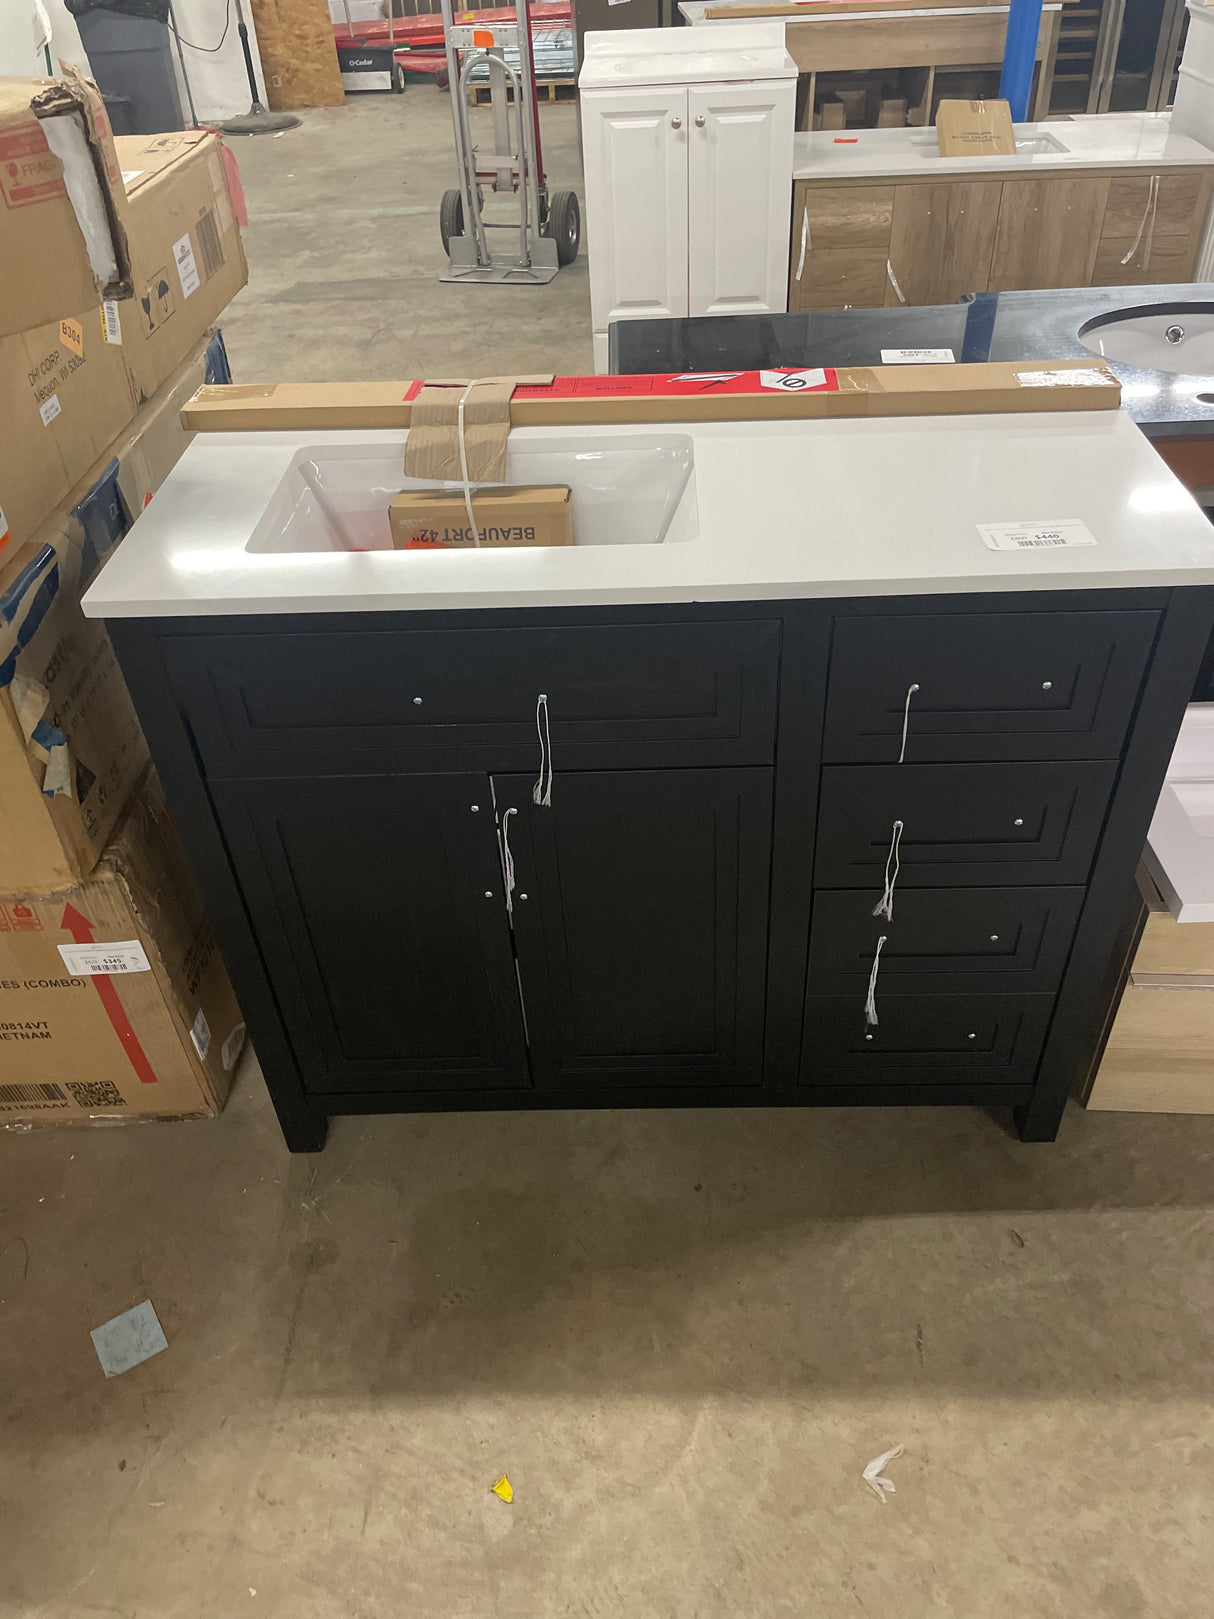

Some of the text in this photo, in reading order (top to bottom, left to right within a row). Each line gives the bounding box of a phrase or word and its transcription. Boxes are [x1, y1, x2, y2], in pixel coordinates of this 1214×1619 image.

[62, 322, 81, 345] B304
[412, 526, 535, 542] BEAUFORT 42"
[0, 979, 87, 990] ES (COMBO)
[0, 1021, 49, 1031] 0814VT
